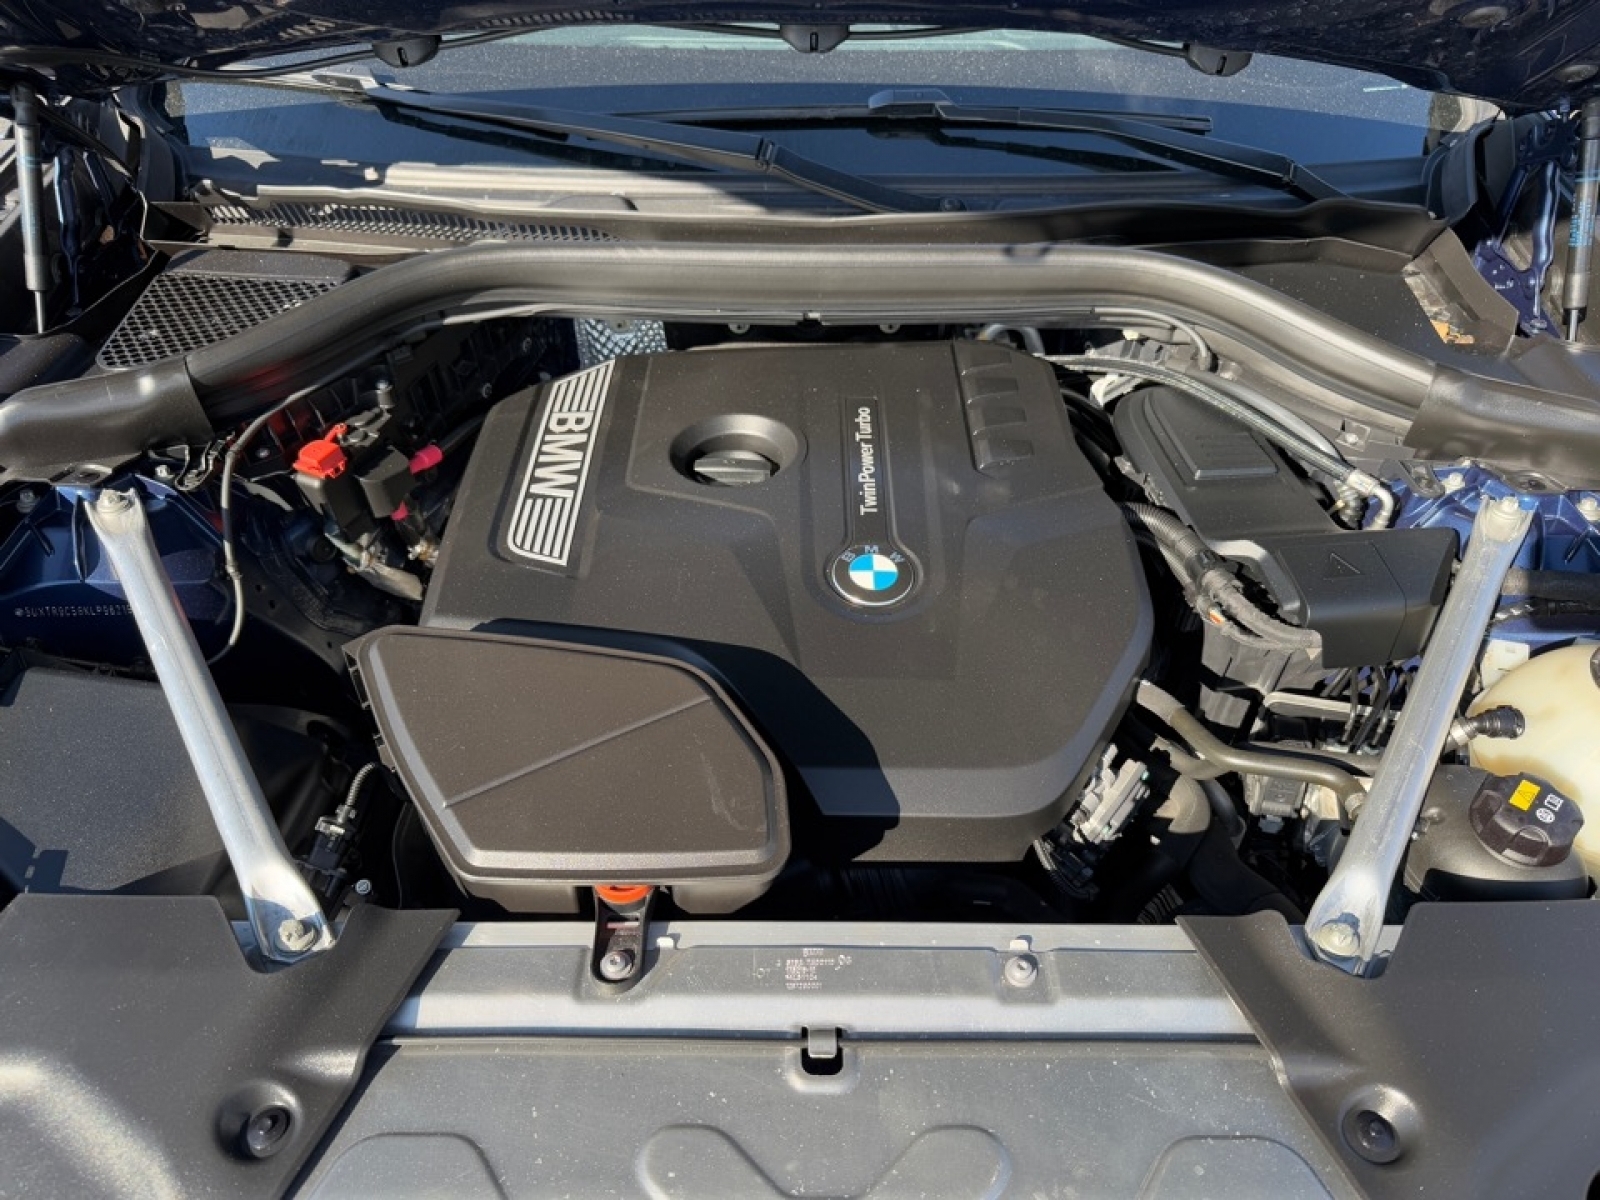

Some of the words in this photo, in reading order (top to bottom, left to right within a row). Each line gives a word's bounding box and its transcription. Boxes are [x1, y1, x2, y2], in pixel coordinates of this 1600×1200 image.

[854, 406, 873, 442] Turbo
[529, 411, 594, 498] BMW
[858, 442, 878, 516] TwinPower
[840, 544, 906, 563] BMW
